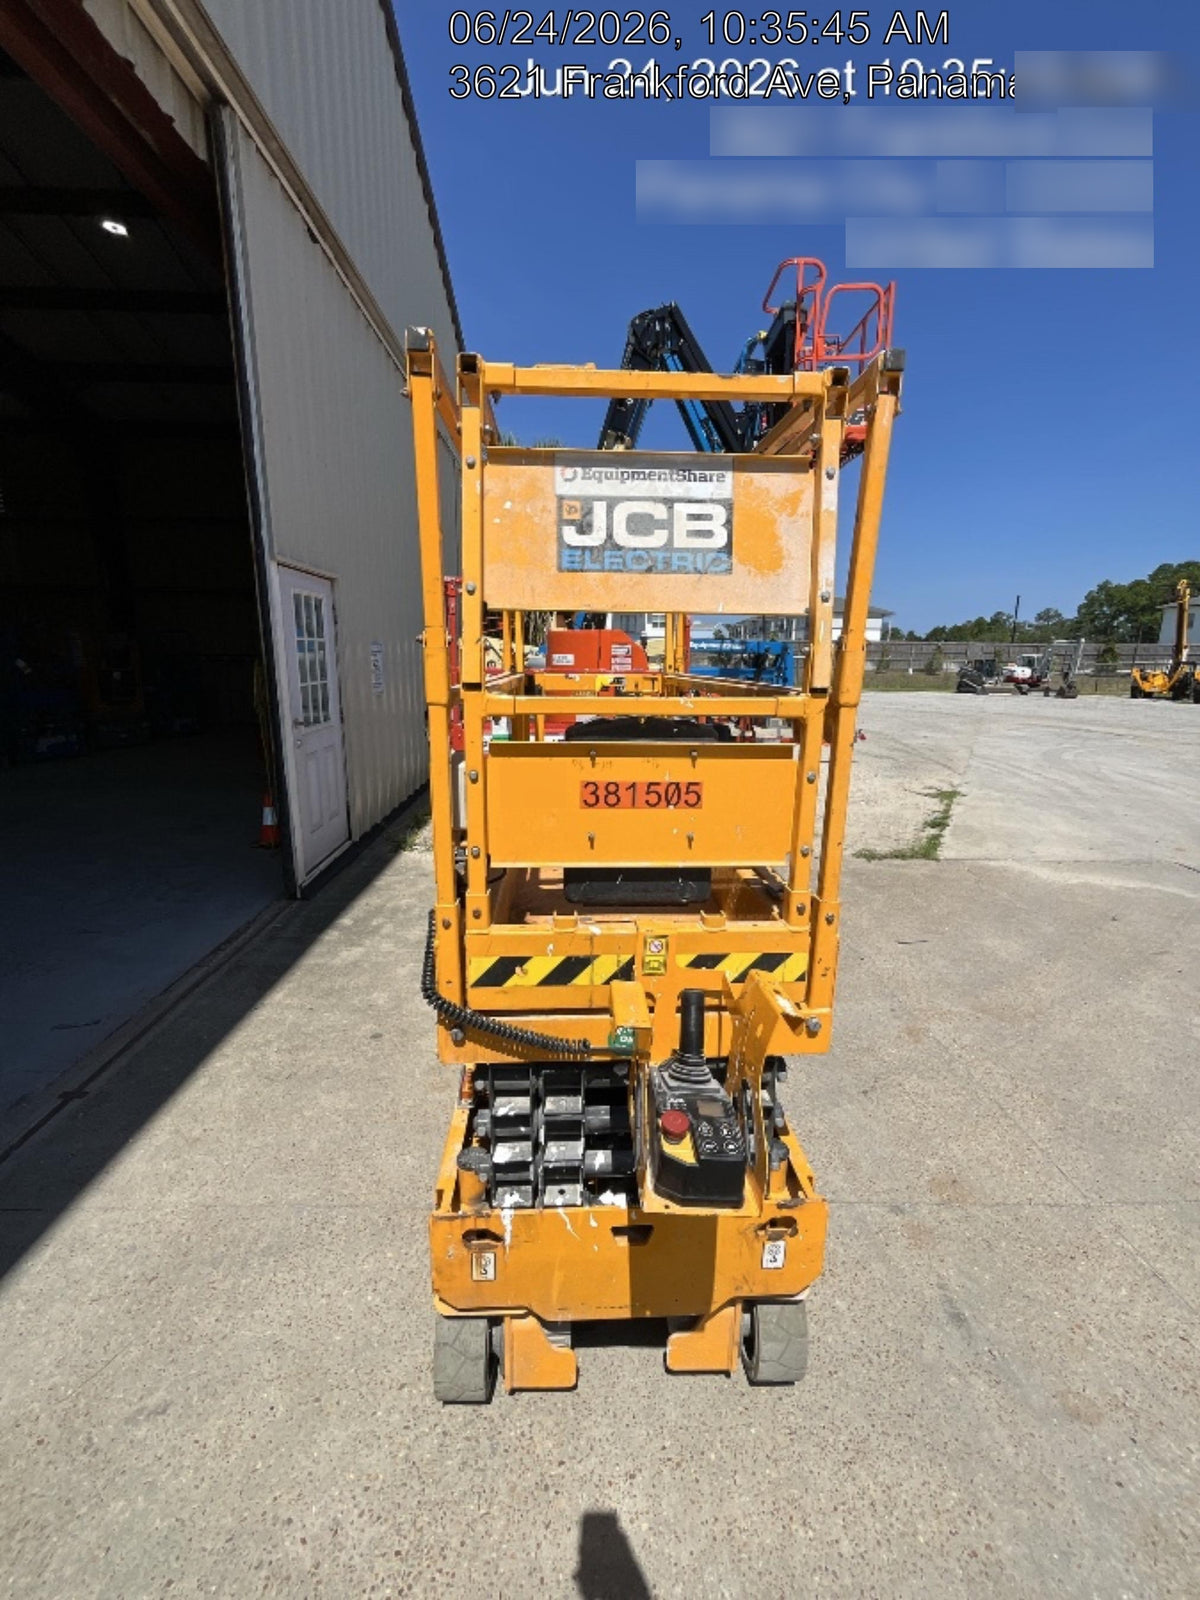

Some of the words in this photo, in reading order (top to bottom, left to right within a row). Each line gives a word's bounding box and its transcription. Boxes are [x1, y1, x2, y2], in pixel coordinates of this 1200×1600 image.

[580, 466, 727, 484] EquipmentShare
[561, 500, 729, 549] JCB
[561, 549, 731, 573] ELECTRIC
[582, 781, 702, 807] 381505
